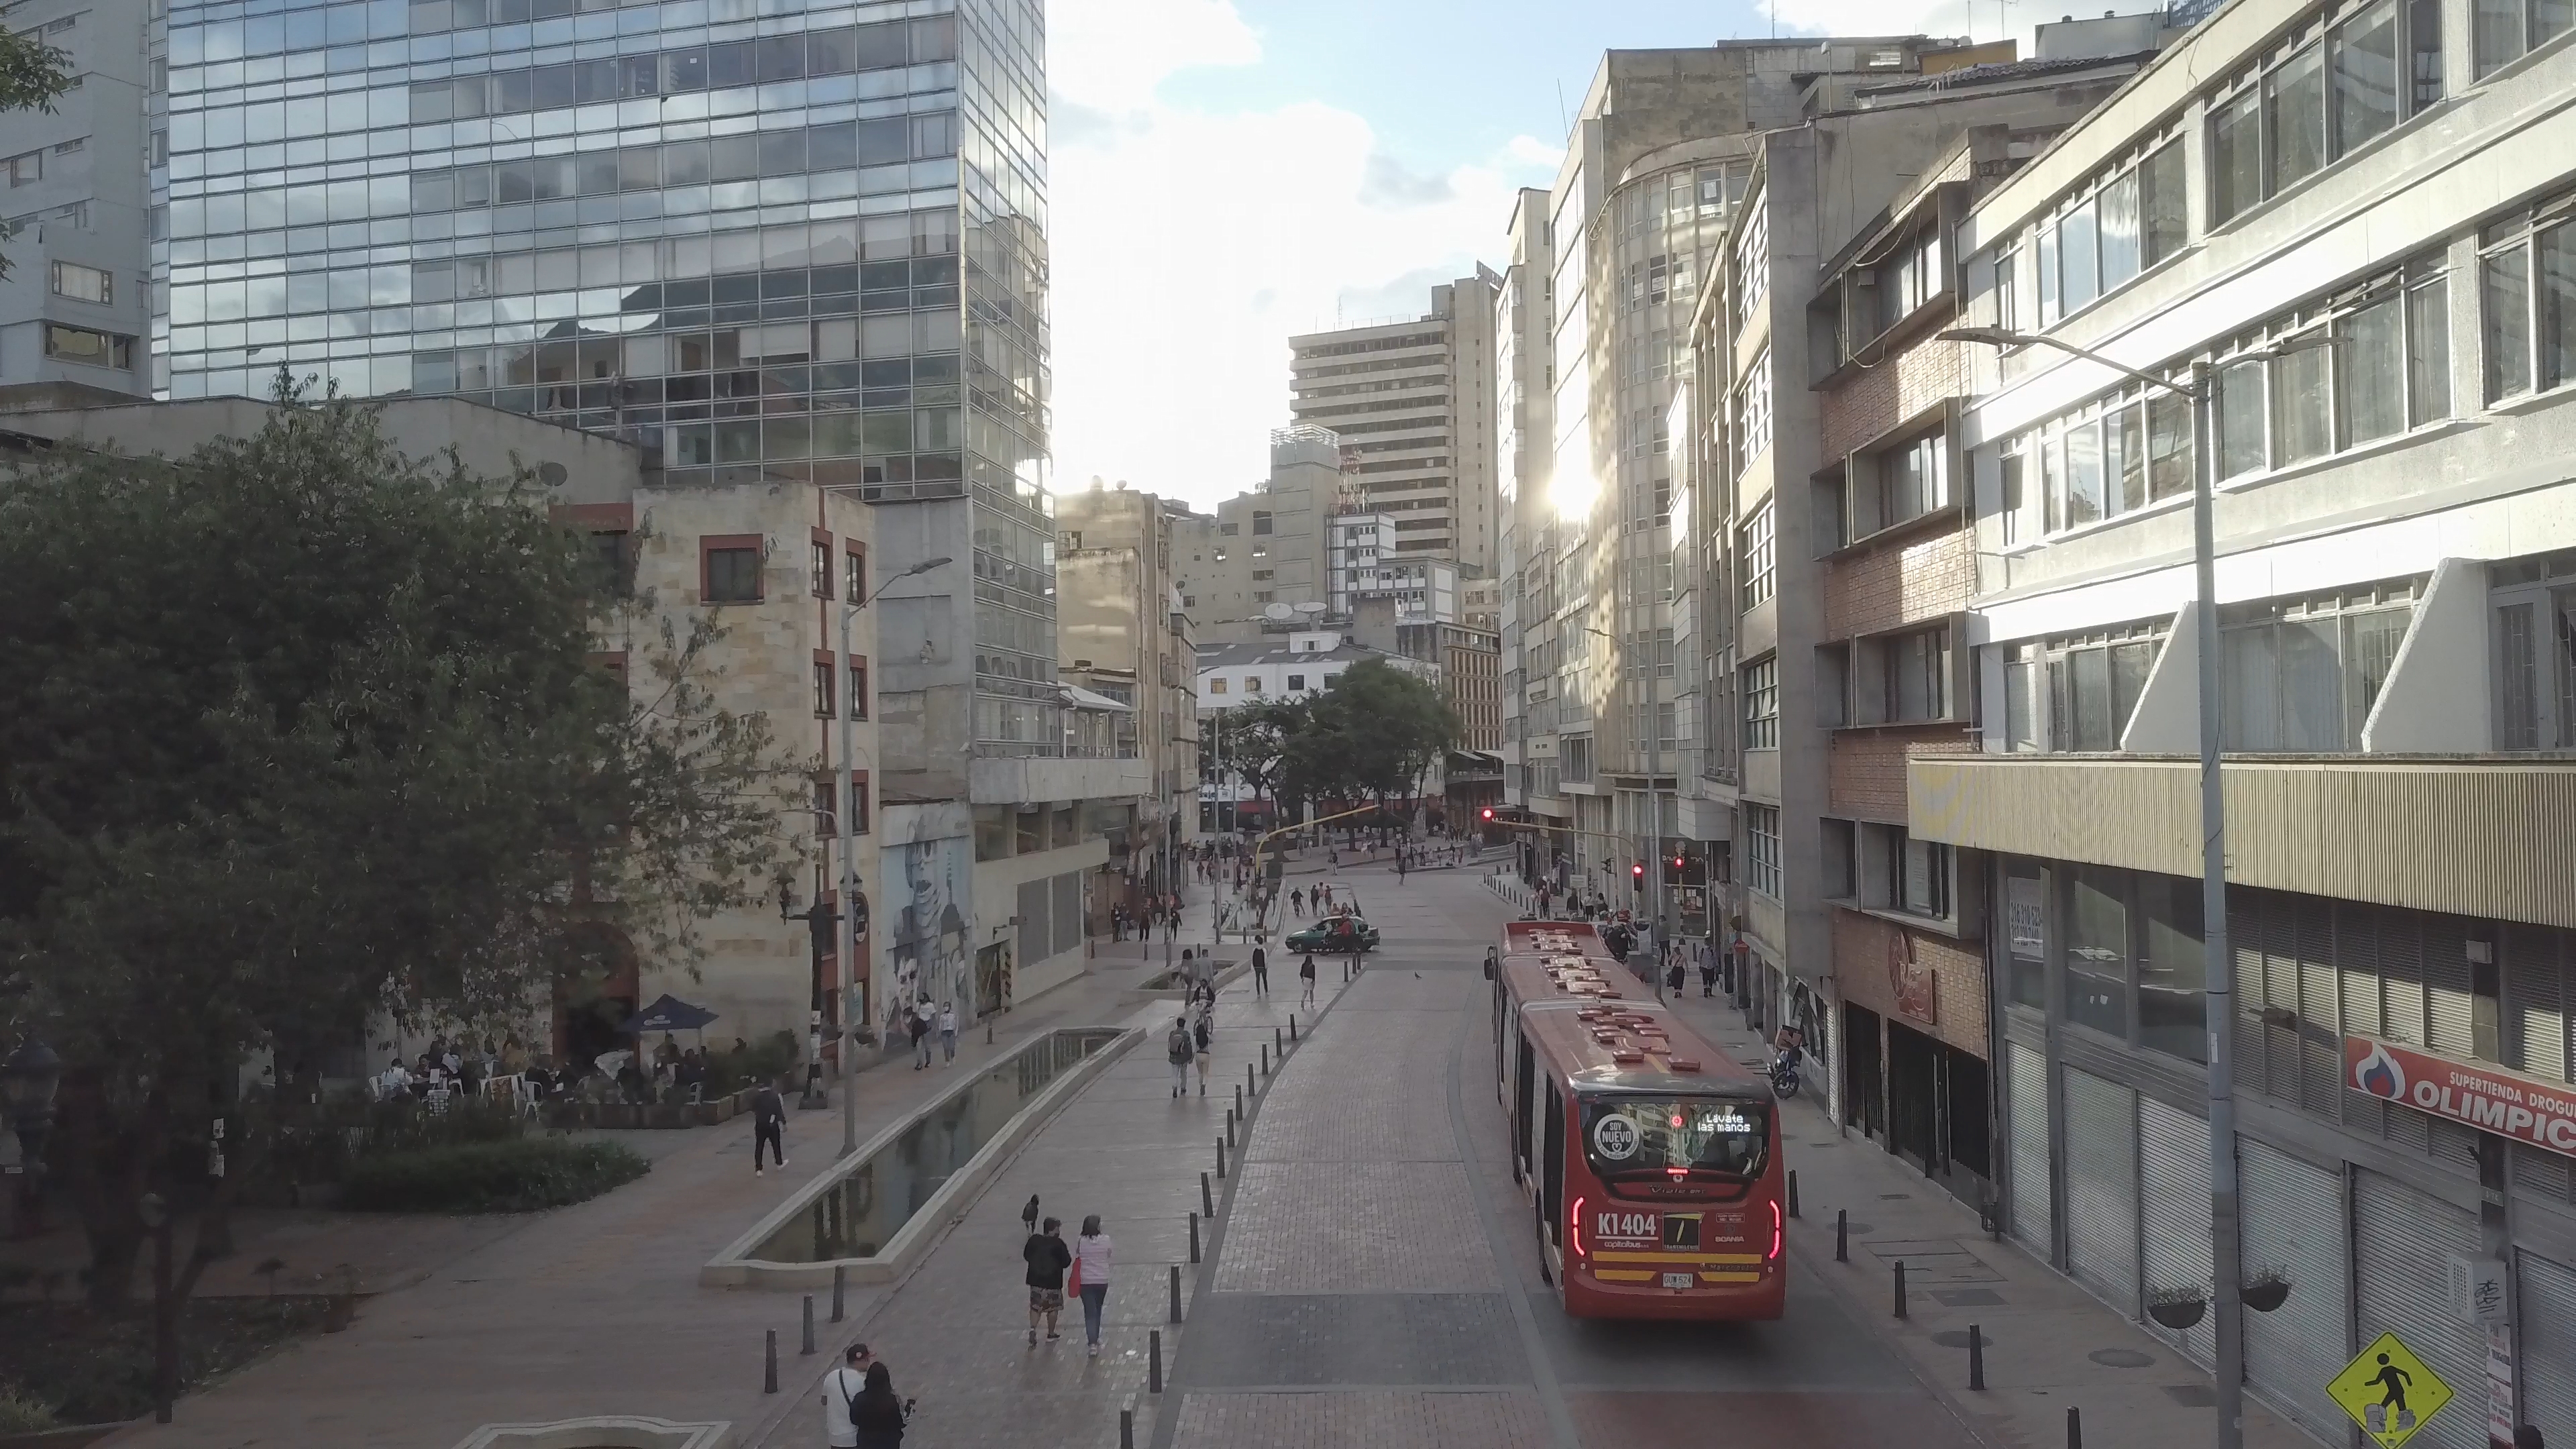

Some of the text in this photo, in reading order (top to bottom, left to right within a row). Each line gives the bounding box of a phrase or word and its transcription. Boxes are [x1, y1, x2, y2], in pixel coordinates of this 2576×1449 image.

[2450, 1071, 2523, 1104] SUPERTIENDA
[1609, 1122, 1622, 1130] SOY
[1698, 1122, 1751, 1132] las manos
[1602, 1131, 1631, 1143] NUEVO
[1598, 1213, 1656, 1236] K1404
